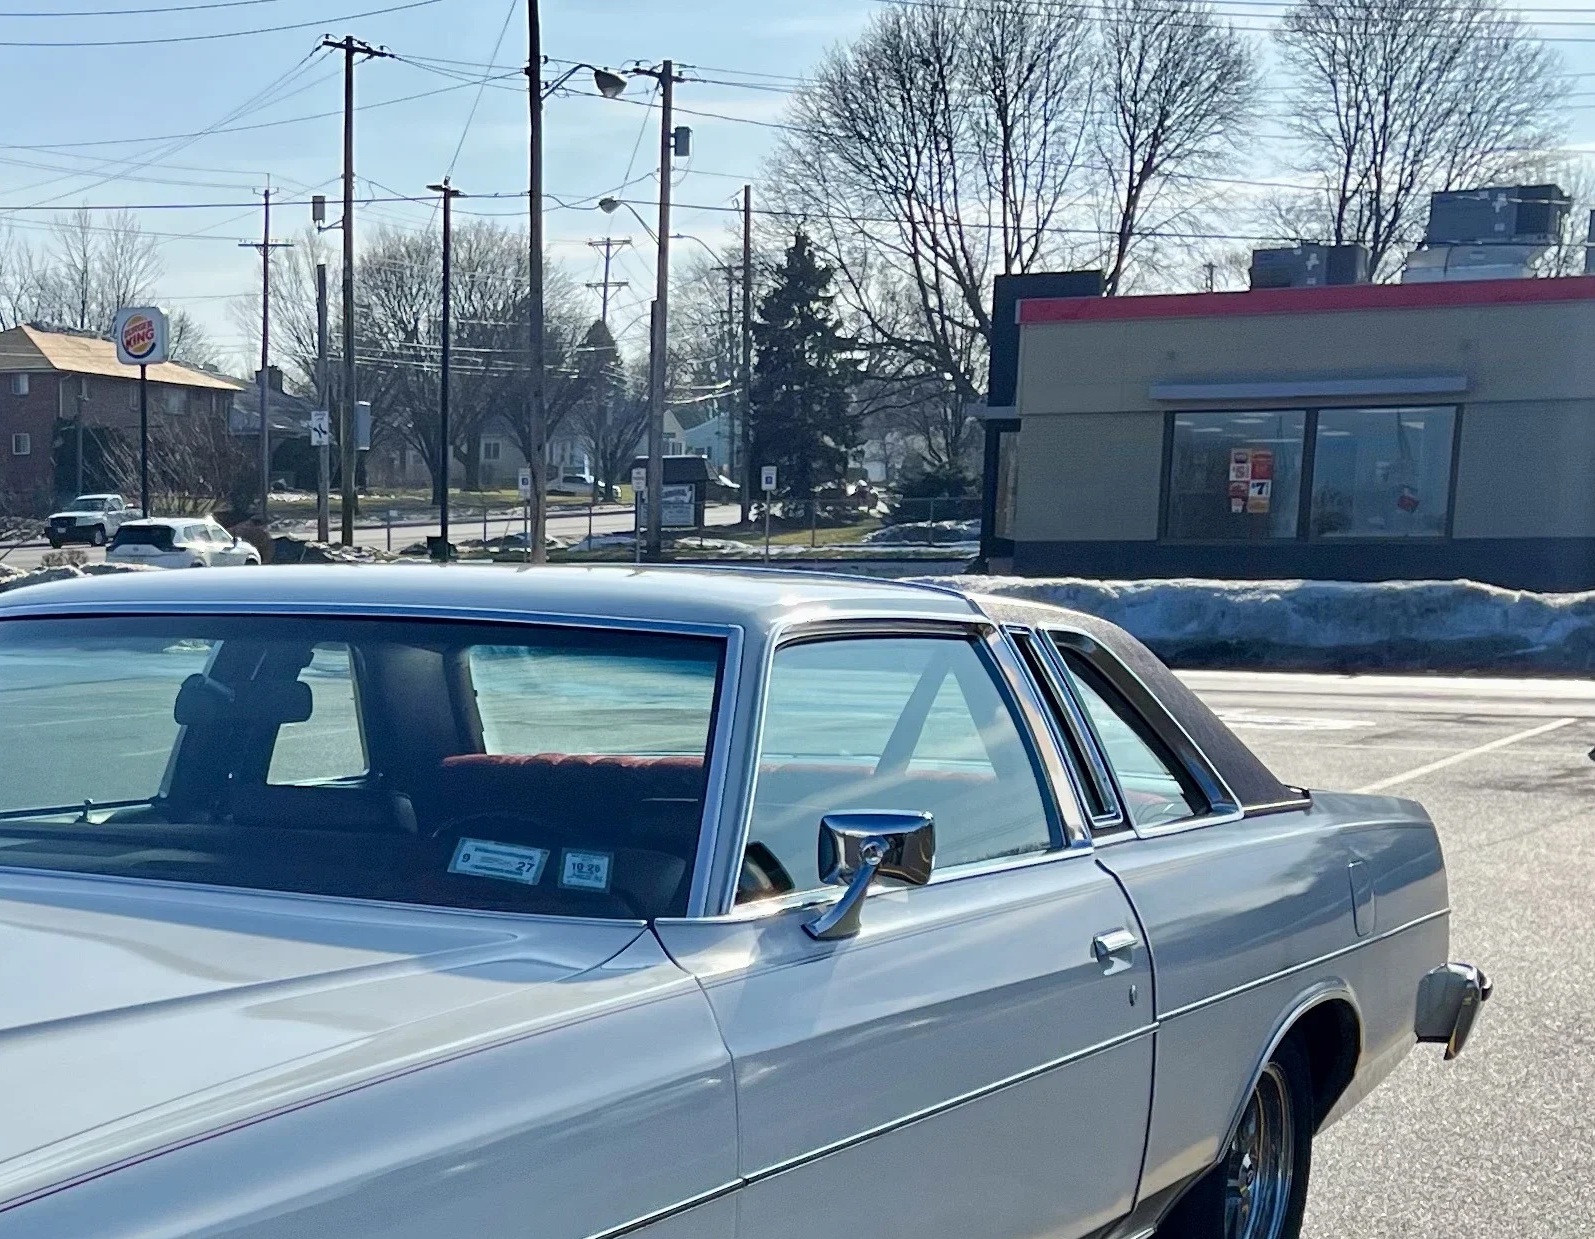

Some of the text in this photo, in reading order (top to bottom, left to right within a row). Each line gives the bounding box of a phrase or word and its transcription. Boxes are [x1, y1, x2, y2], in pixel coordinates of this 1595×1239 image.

[124, 320, 153, 338] BURGER
[126, 328, 154, 349] KING
[462, 853, 471, 862] 9
[516, 861, 535, 873] 27
[572, 862, 584, 870] 10
